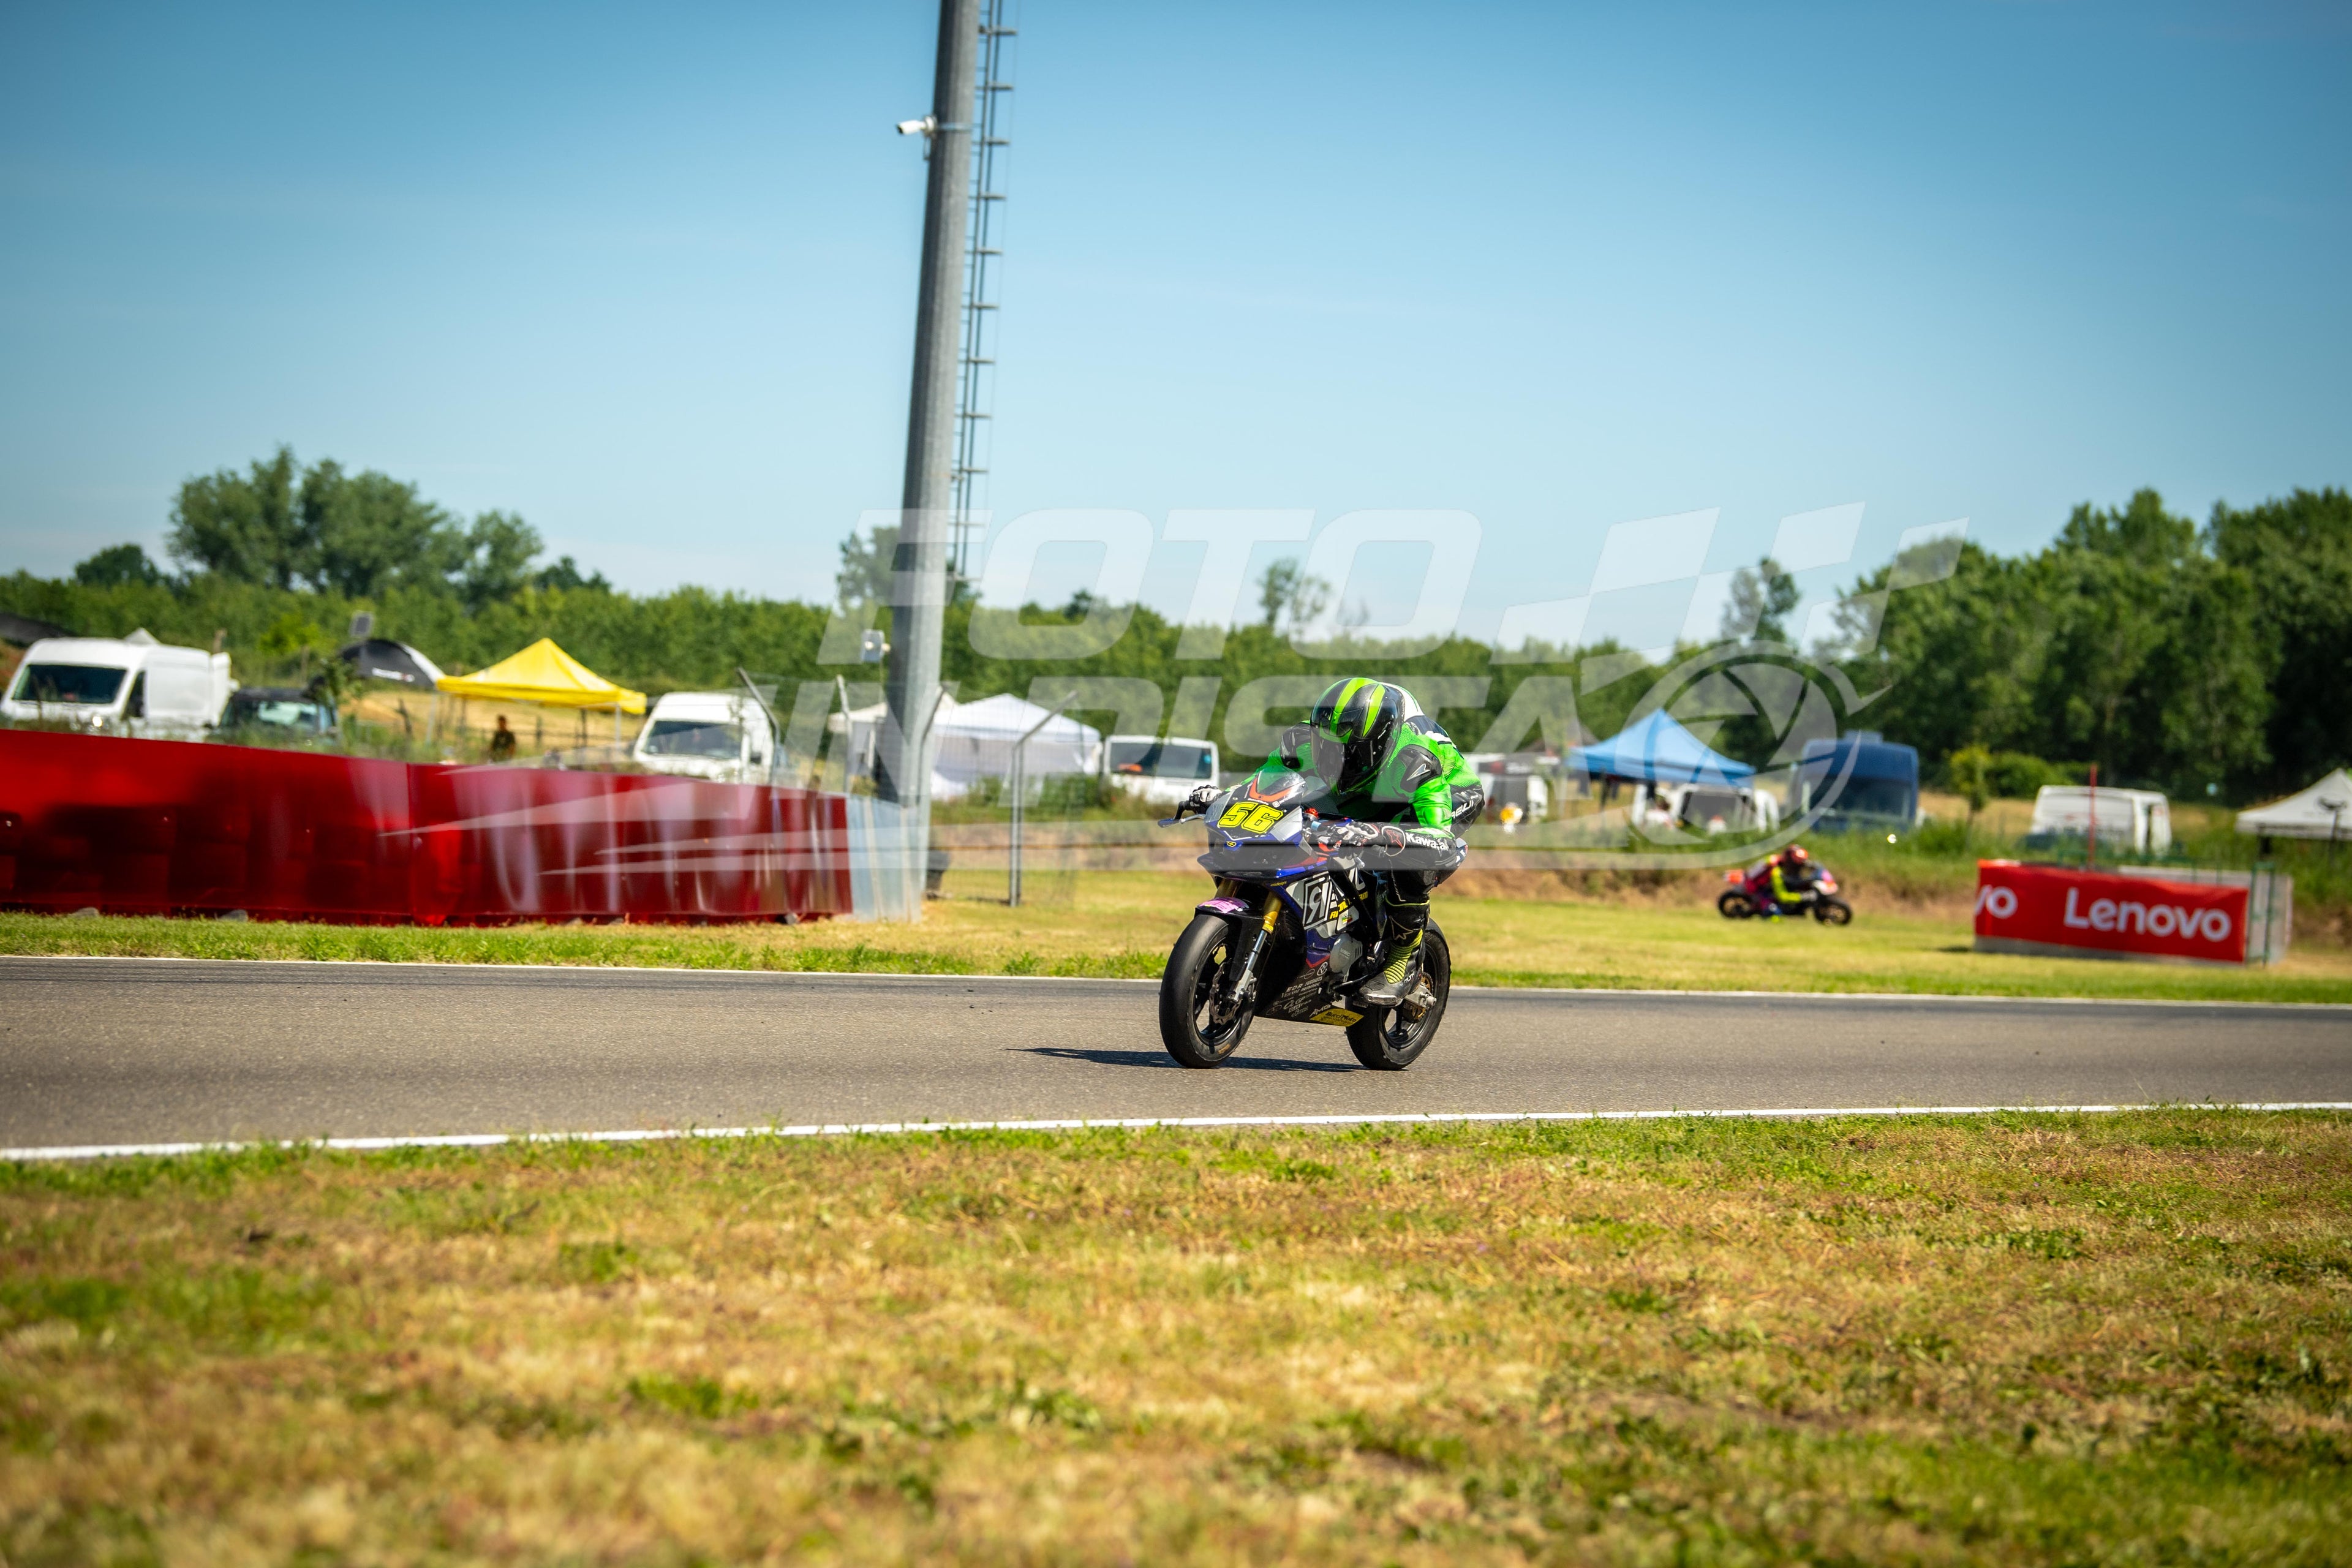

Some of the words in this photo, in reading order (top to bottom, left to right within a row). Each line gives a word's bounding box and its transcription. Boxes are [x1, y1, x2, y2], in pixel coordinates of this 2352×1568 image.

[1217, 801, 1283, 834] 56
[1405, 832, 1450, 851] Kawaa
[2063, 886, 2232, 943] Lenovo
